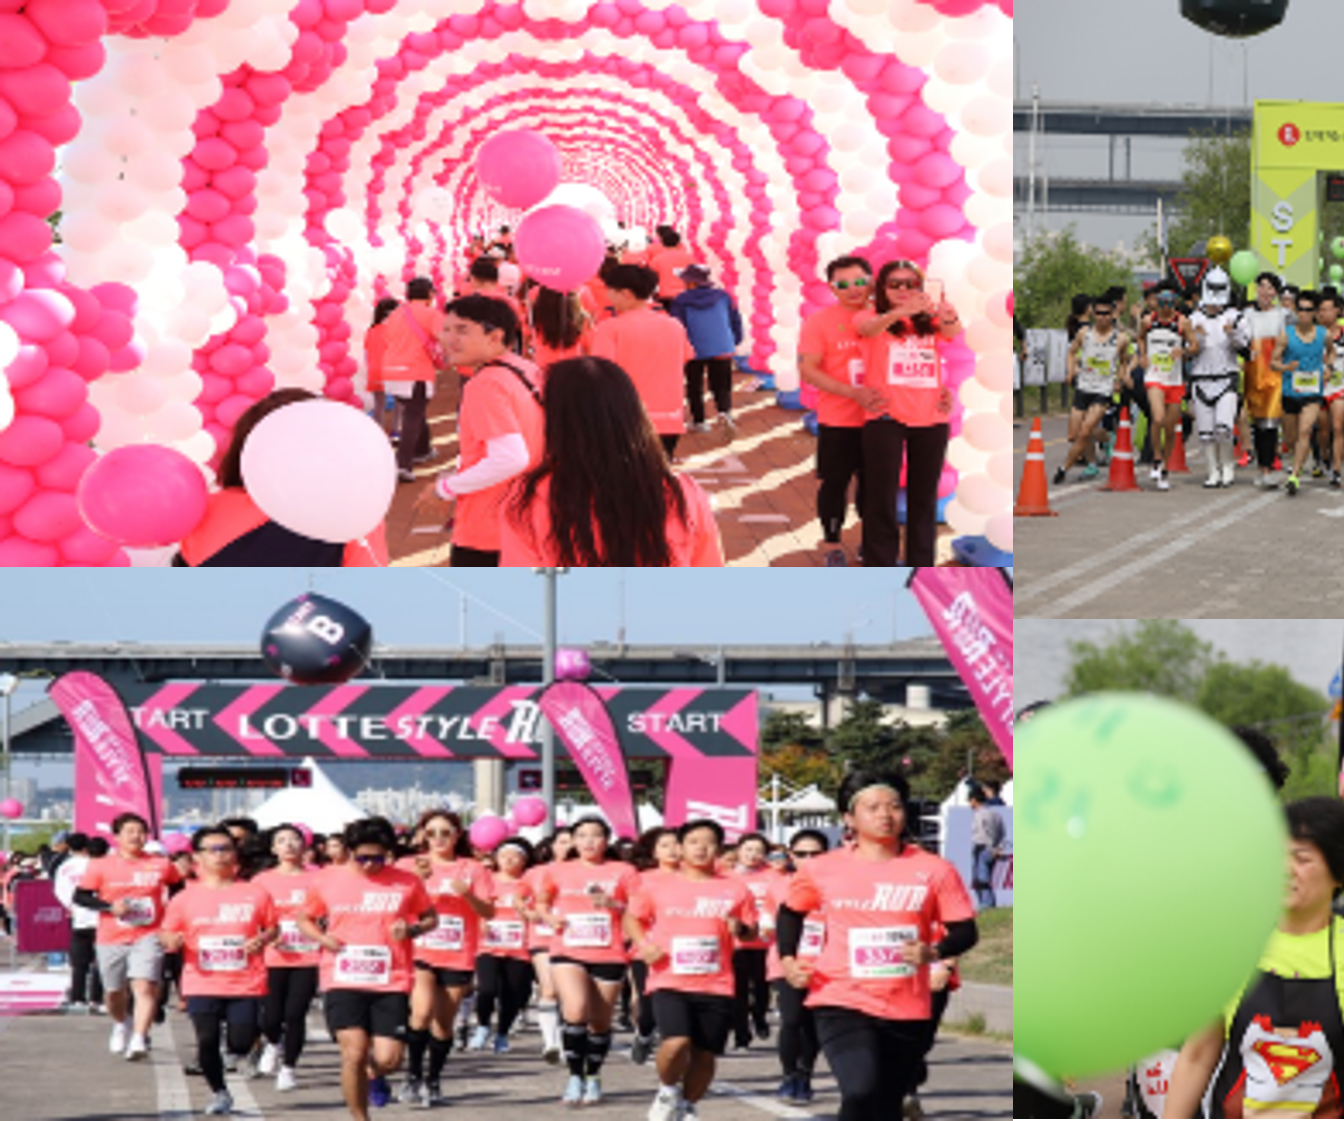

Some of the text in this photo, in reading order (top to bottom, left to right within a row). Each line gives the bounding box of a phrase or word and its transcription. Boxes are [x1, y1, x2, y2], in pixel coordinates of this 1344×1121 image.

[129, 706, 209, 730] TART
[238, 713, 387, 740] LOTTE
[395, 714, 499, 741] STYLE
[626, 711, 724, 734] START
